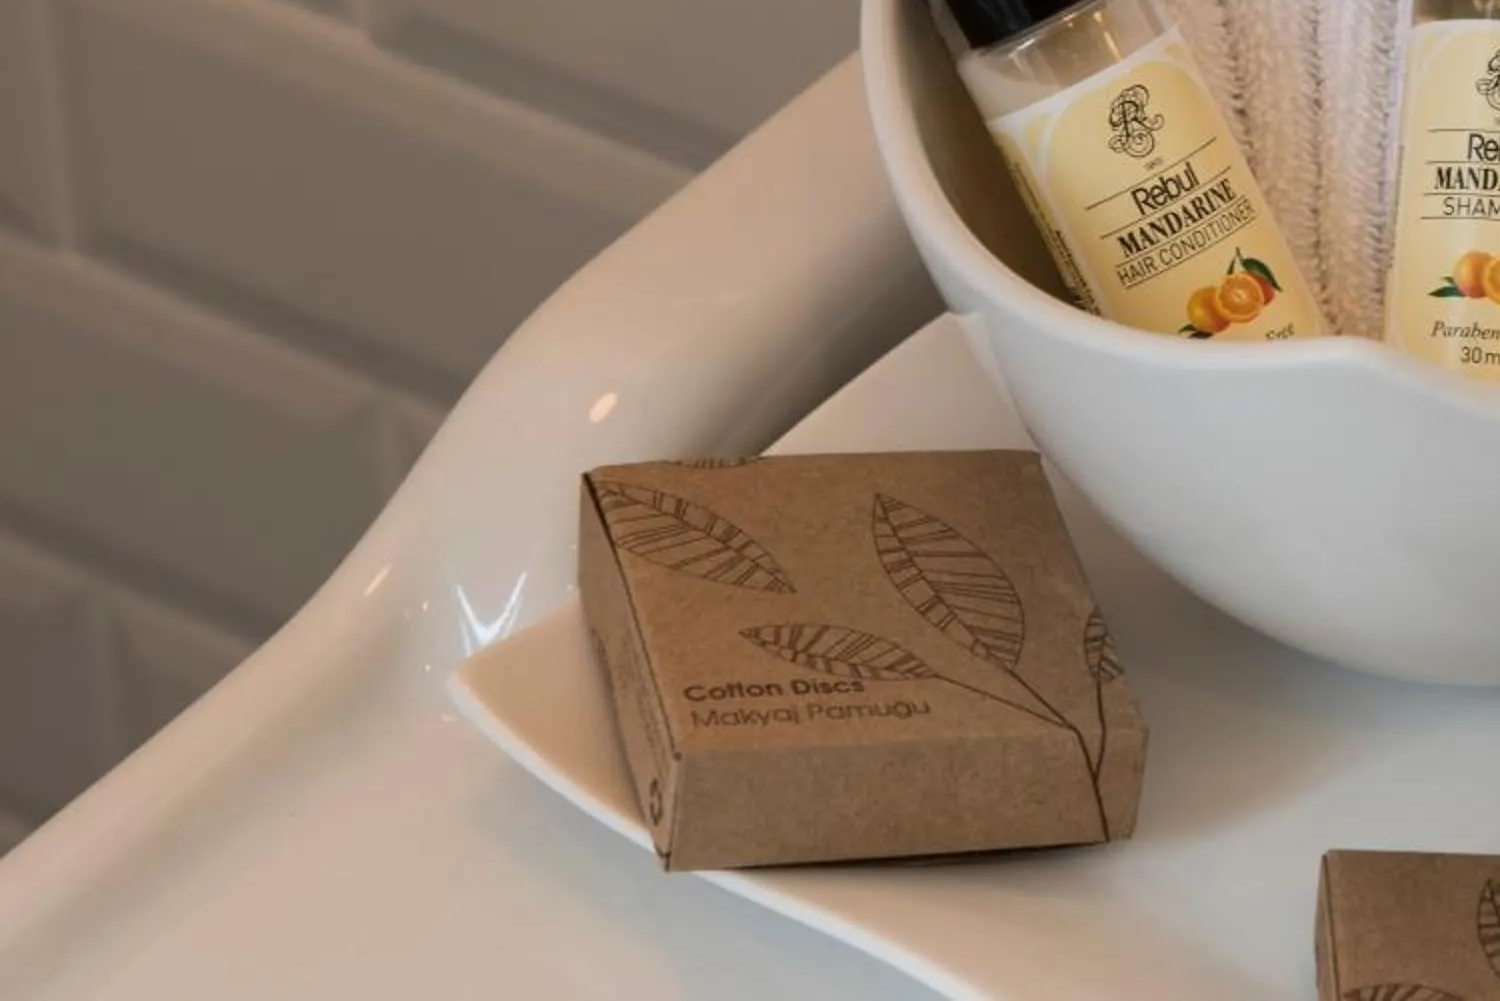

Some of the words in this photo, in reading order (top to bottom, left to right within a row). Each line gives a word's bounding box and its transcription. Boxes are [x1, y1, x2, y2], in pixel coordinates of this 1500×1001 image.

[1132, 161, 1200, 216] Rebul
[1116, 178, 1238, 258] MANDARINE
[1116, 255, 1159, 286] HAIR
[1159, 201, 1256, 267] CONDITIONER
[1431, 320, 1500, 341] Paraben
[683, 681, 784, 702] Cotton
[790, 677, 865, 696] Discs
[690, 706, 801, 728] Makyaj
